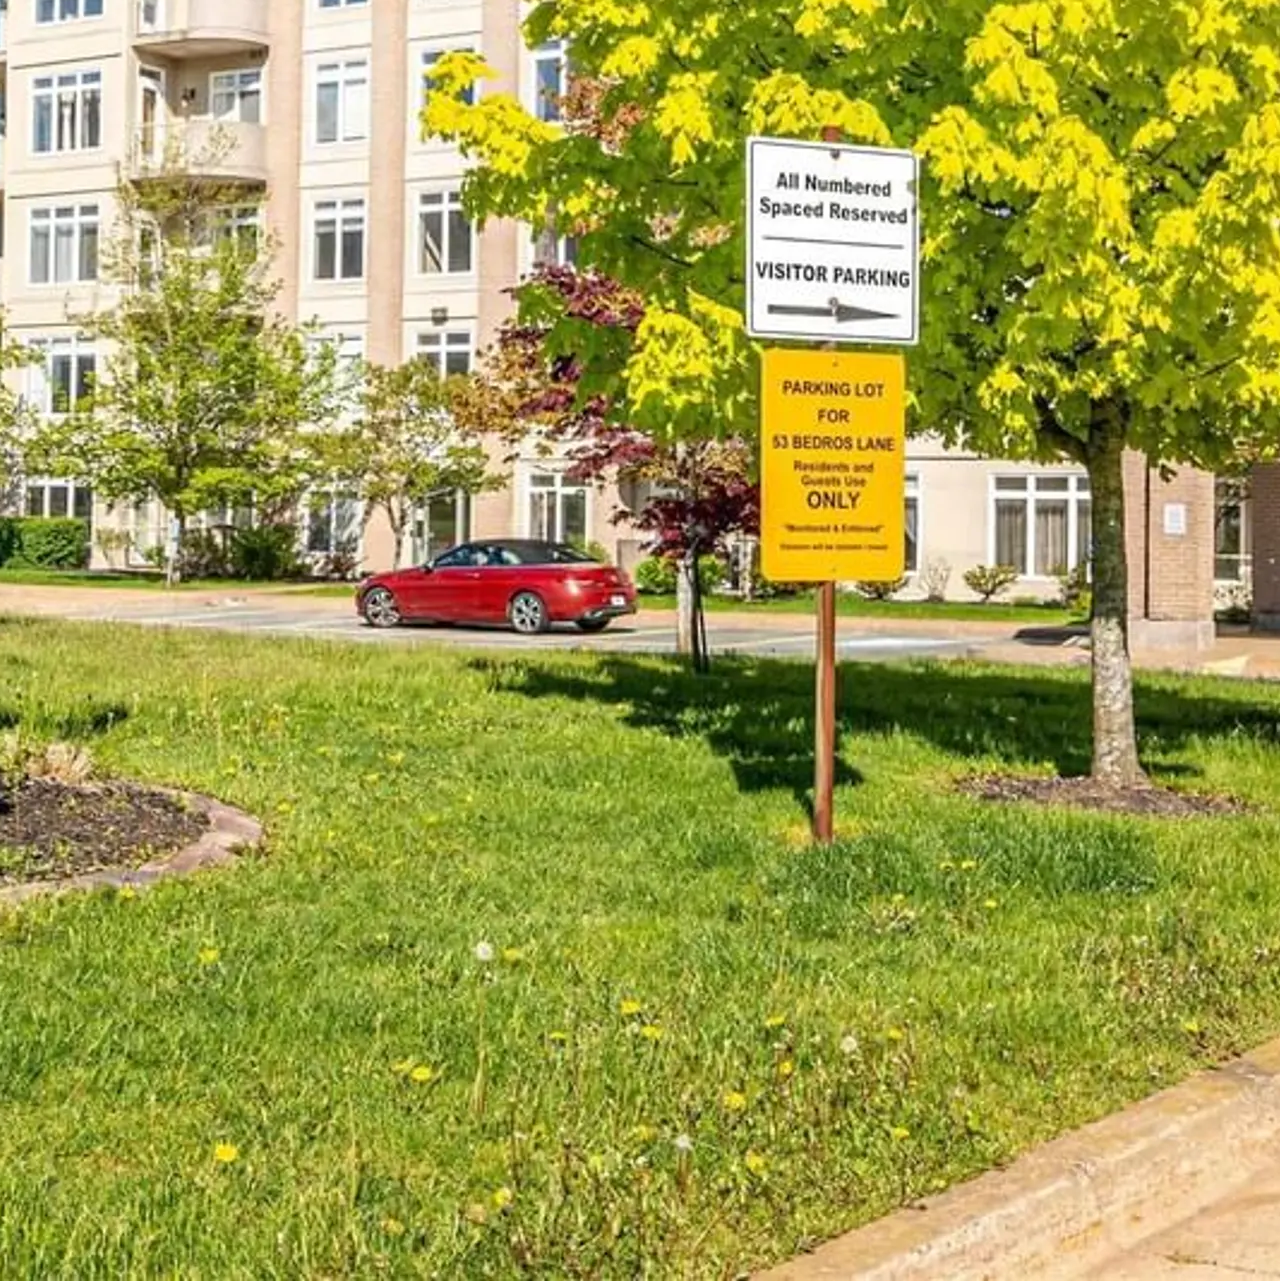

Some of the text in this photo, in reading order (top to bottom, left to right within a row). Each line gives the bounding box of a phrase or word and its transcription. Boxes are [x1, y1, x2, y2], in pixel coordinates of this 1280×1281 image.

[776, 172, 892, 197] All Numbered
[759, 196, 908, 224] Spaced Reserved
[755, 261, 911, 288] VISITOR PARKING
[782, 380, 885, 398] PARKING LOT
[817, 409, 850, 424] FOR
[772, 433, 895, 452] 53 BEDROS LANE
[793, 460, 874, 473] Residents and
[801, 475, 867, 487] Guests Use
[807, 491, 860, 509] ONLY
